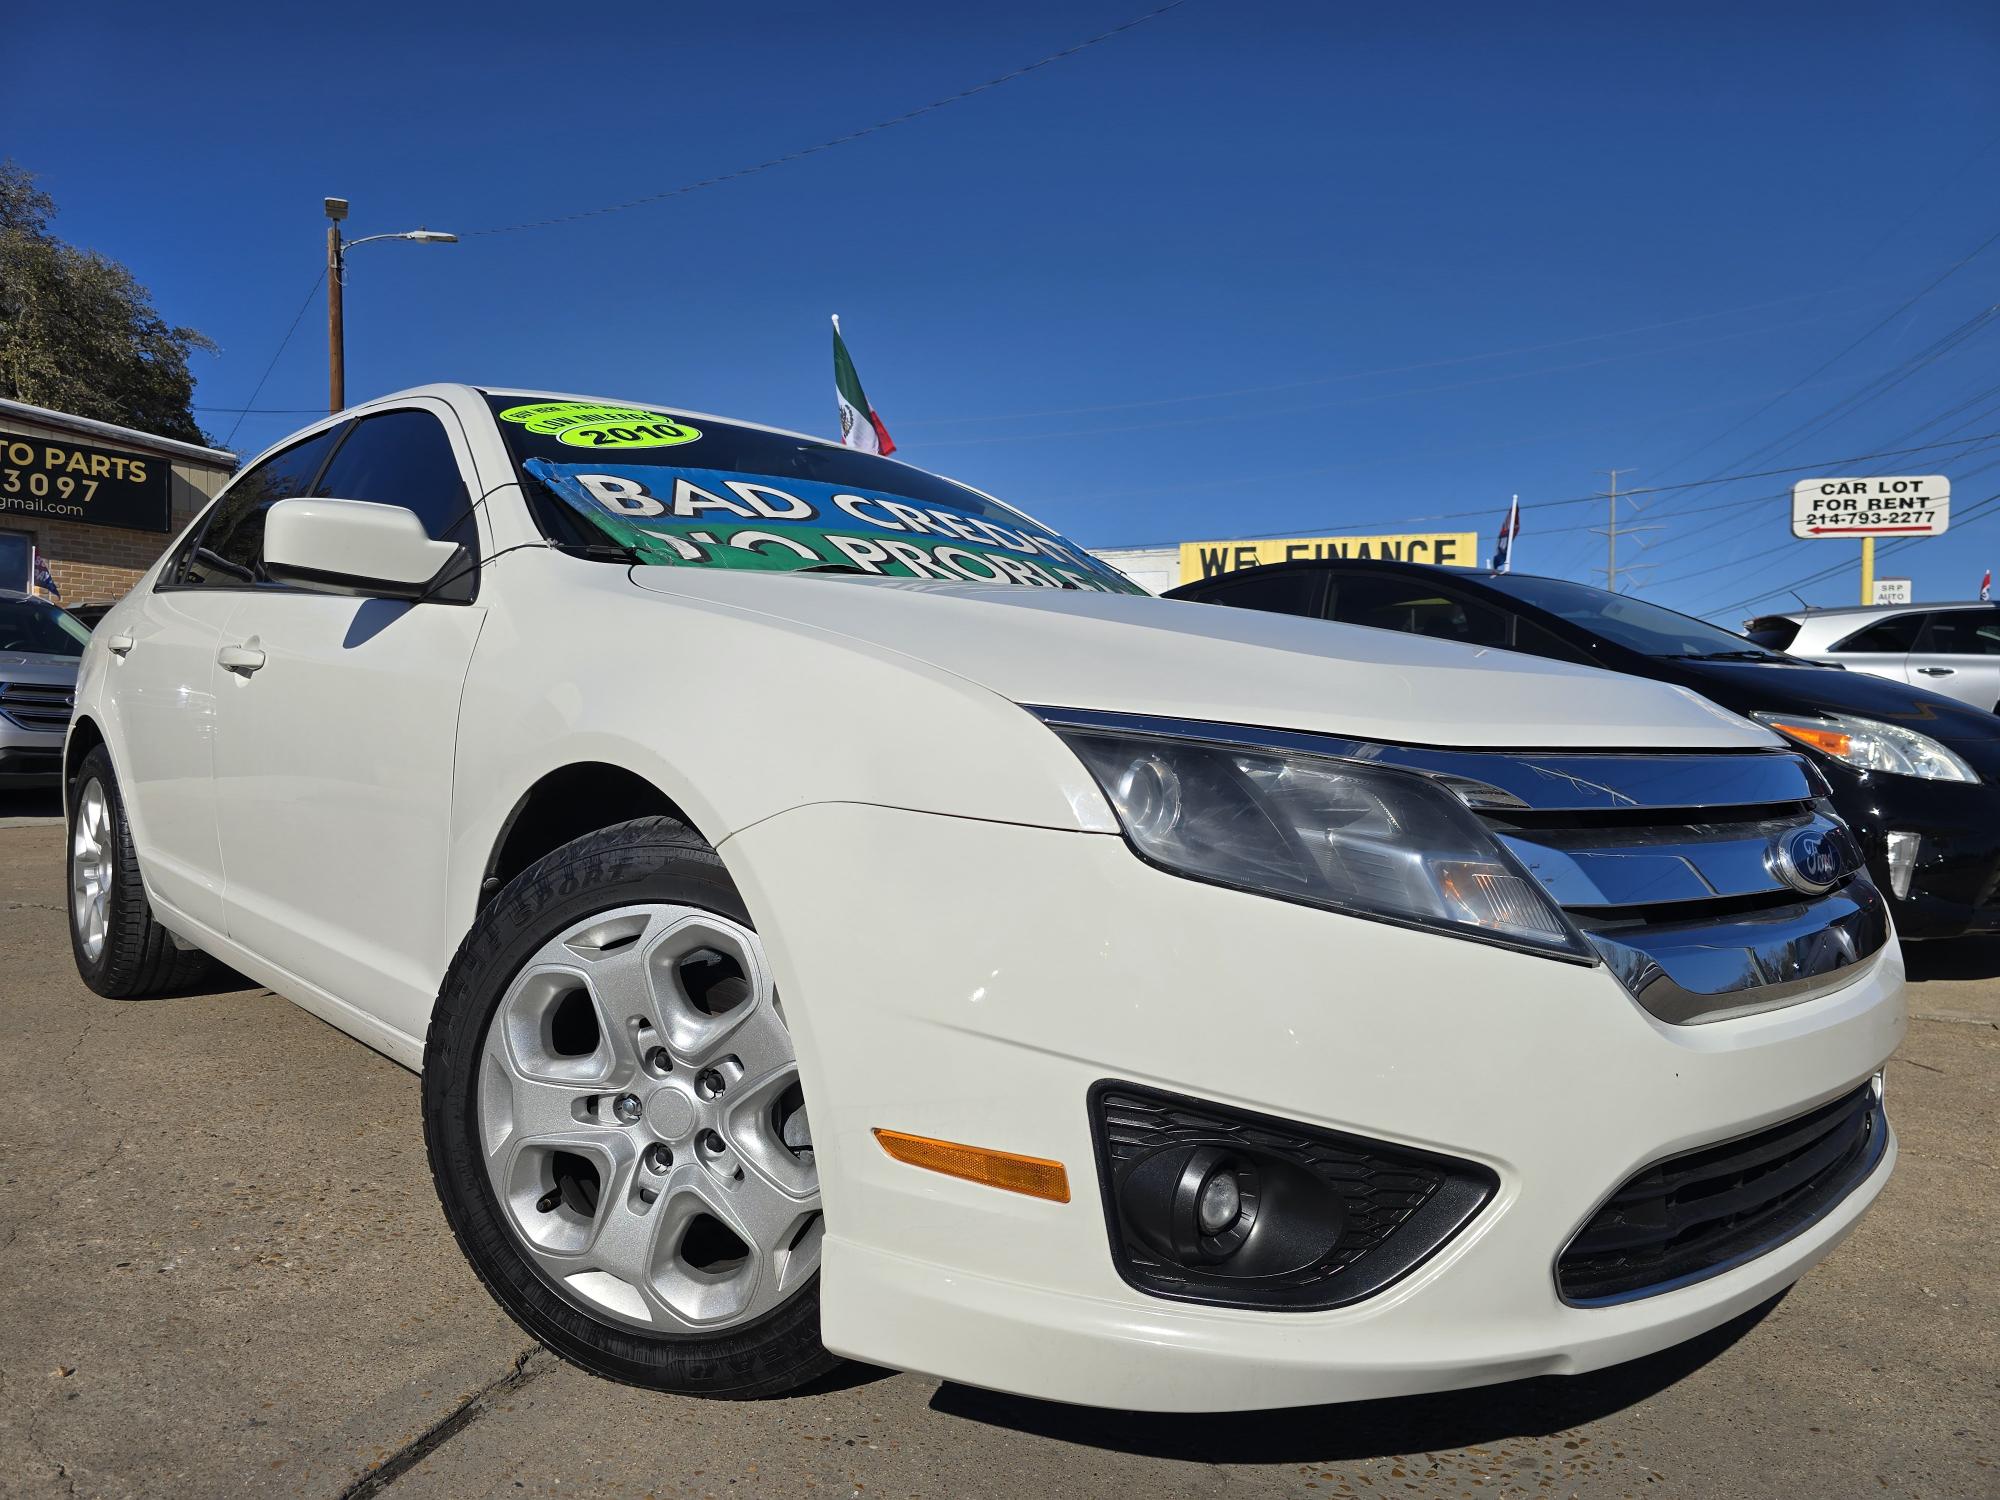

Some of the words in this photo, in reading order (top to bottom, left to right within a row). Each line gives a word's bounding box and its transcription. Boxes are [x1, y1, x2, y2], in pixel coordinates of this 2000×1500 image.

[537, 416, 578, 431] LOW
[576, 413, 658, 424] MILEAGE
[579, 424, 686, 446] 2010
[45, 447, 147, 483] PARTS
[3, 469, 99, 502] 3097
[1821, 482, 1868, 495] CAR
[1879, 481, 1924, 494] LOT
[574, 473, 814, 521] BAD
[1813, 499, 1857, 511] FOR
[1868, 497, 1930, 511] RENT
[1806, 511, 1936, 525] 214-793-2277
[1199, 546, 1257, 579] WE
[1878, 593, 1905, 601] AUTO
[1803, 838, 1836, 876] Ford
